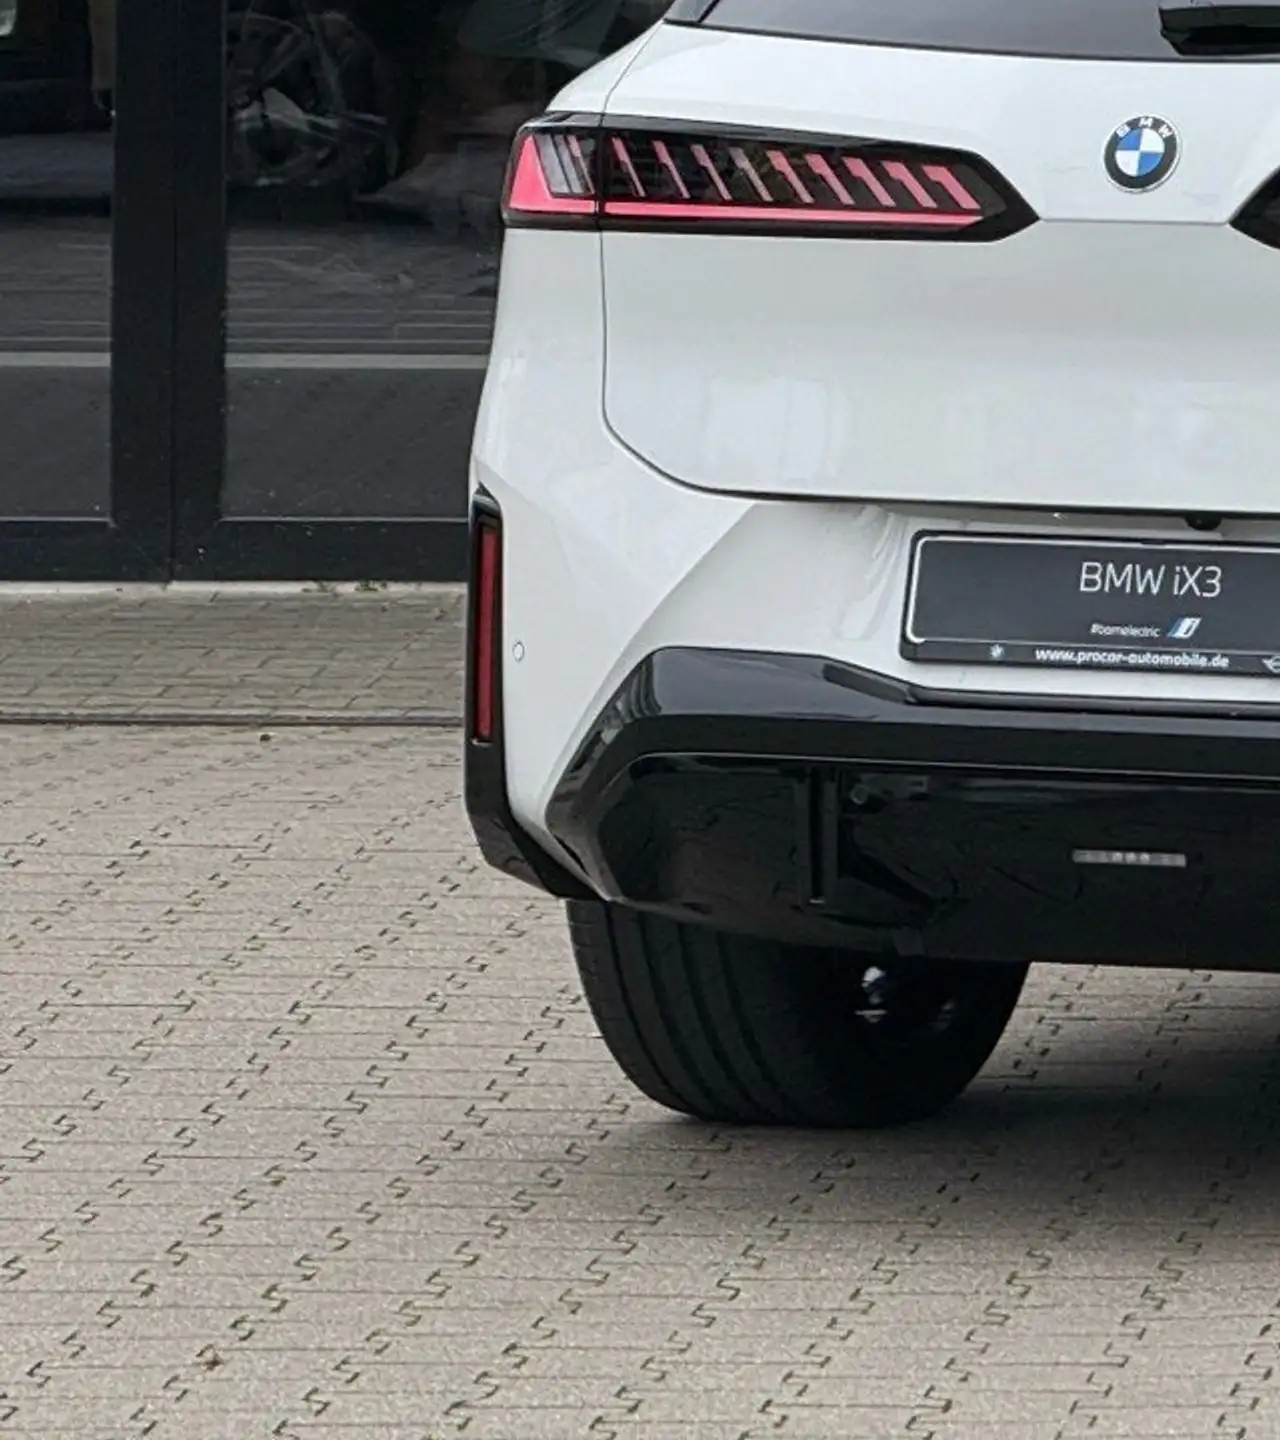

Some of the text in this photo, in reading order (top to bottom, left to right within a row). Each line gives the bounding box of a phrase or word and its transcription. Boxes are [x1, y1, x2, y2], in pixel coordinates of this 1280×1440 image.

[1079, 561, 1222, 598] BMW iX3
[1035, 648, 1230, 668] www.procar-automobile.de
